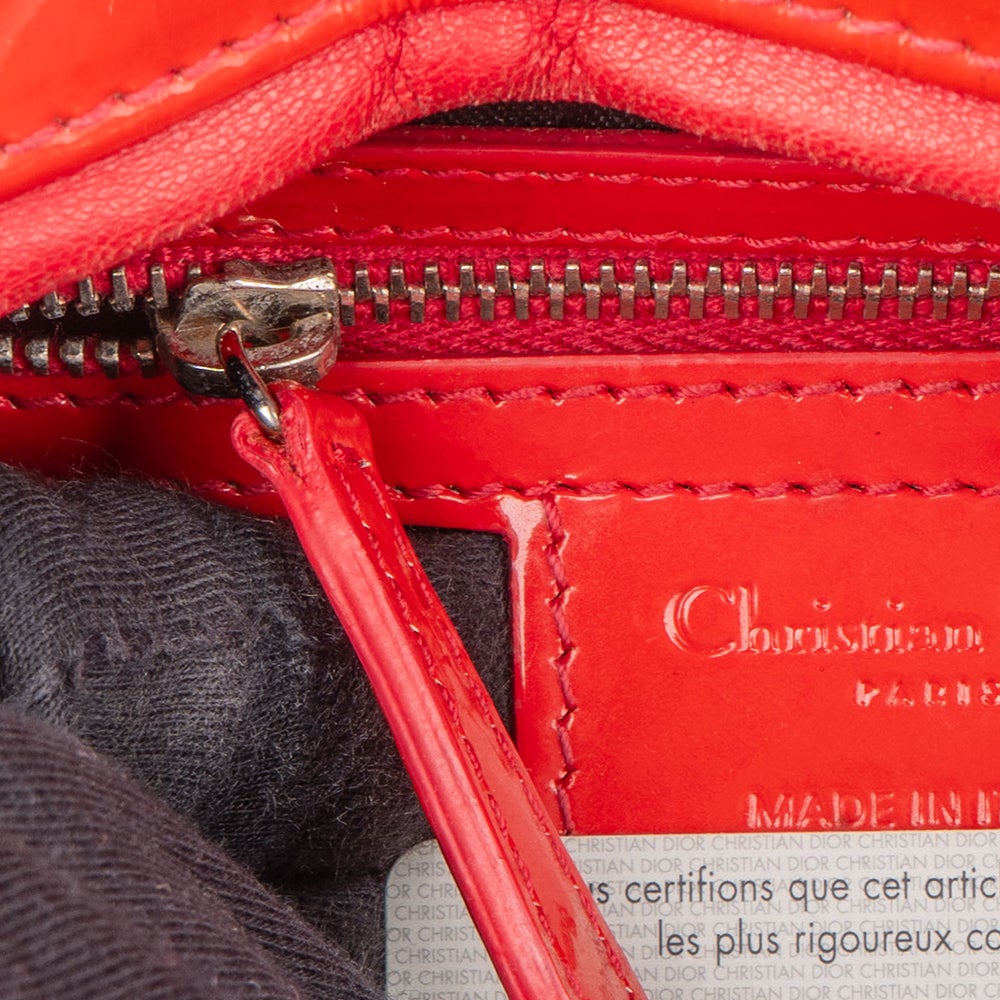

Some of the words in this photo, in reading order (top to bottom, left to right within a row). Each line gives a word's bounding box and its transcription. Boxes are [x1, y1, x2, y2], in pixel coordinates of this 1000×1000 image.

[663, 582, 985, 658] Christian
[747, 791, 895, 828] MADE
[911, 789, 962, 827] IN
[625, 864, 773, 904] certifions
[789, 878, 849, 912] que
[864, 876, 911, 900] cet
[658, 919, 700, 956] les
[716, 918, 779, 966] plus
[796, 929, 953, 963] rigoureux
